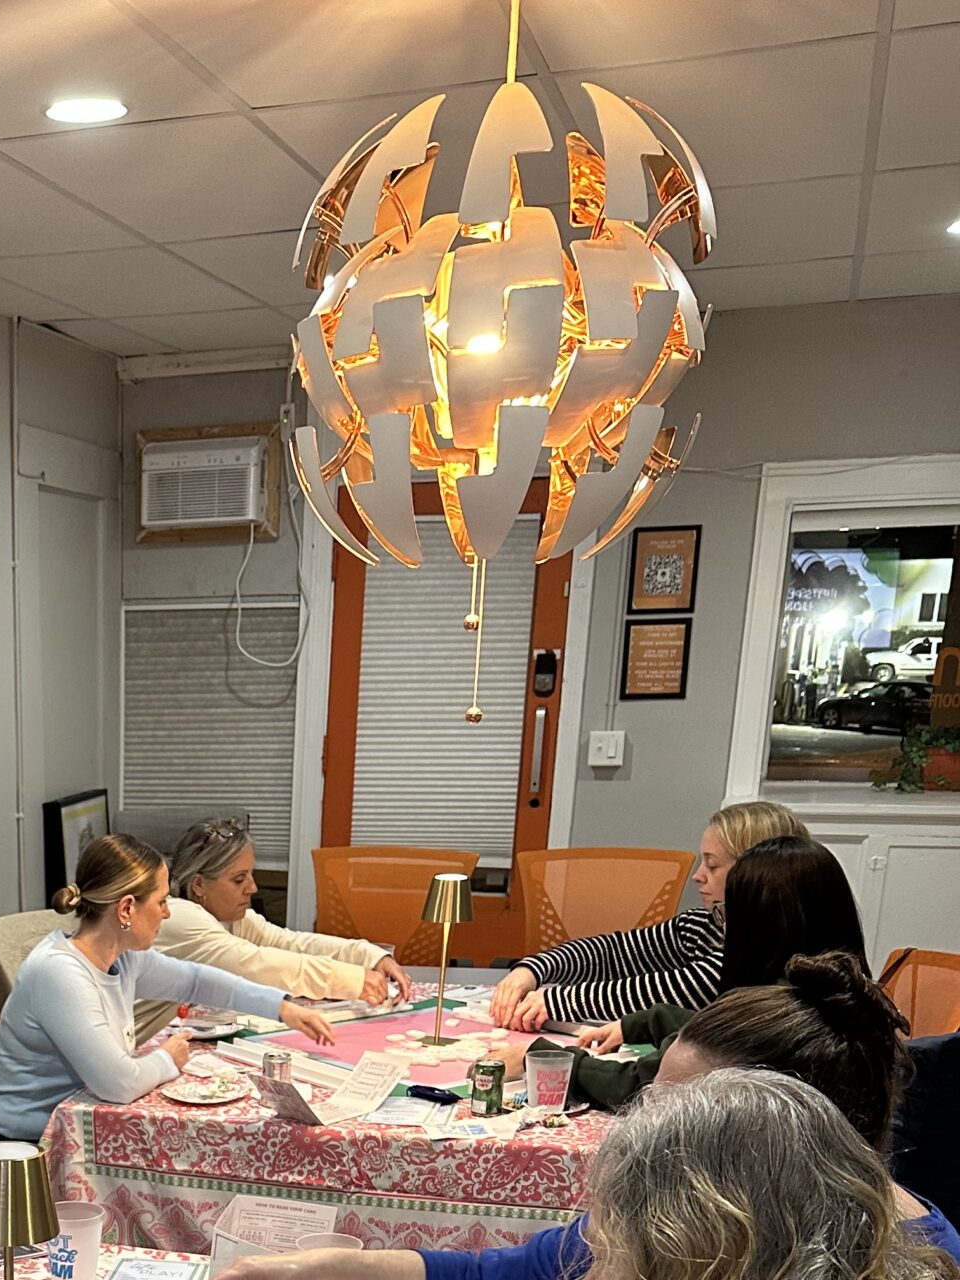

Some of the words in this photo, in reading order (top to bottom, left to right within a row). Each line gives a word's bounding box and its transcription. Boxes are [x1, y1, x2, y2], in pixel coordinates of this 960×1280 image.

[48, 1235, 72, 1249] OT
[50, 1248, 77, 1262] ack
[49, 1264, 74, 1280] AM
